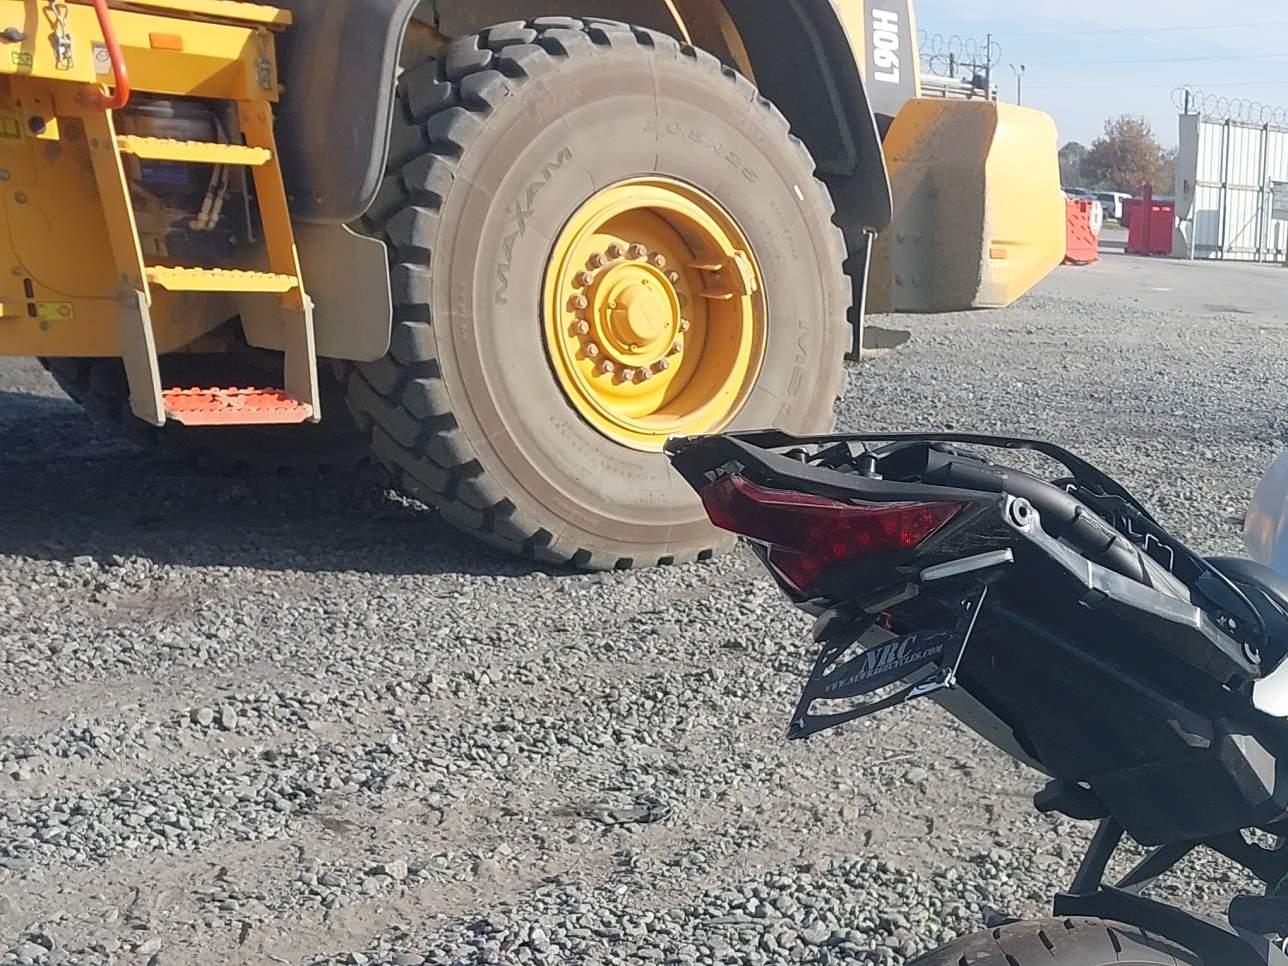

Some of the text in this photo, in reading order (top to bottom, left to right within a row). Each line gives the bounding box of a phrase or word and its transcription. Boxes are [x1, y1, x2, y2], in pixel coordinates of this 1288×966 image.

[872, 9, 900, 84] L90H
[495, 146, 573, 305] MAXAM
[860, 634, 917, 673] NRC
